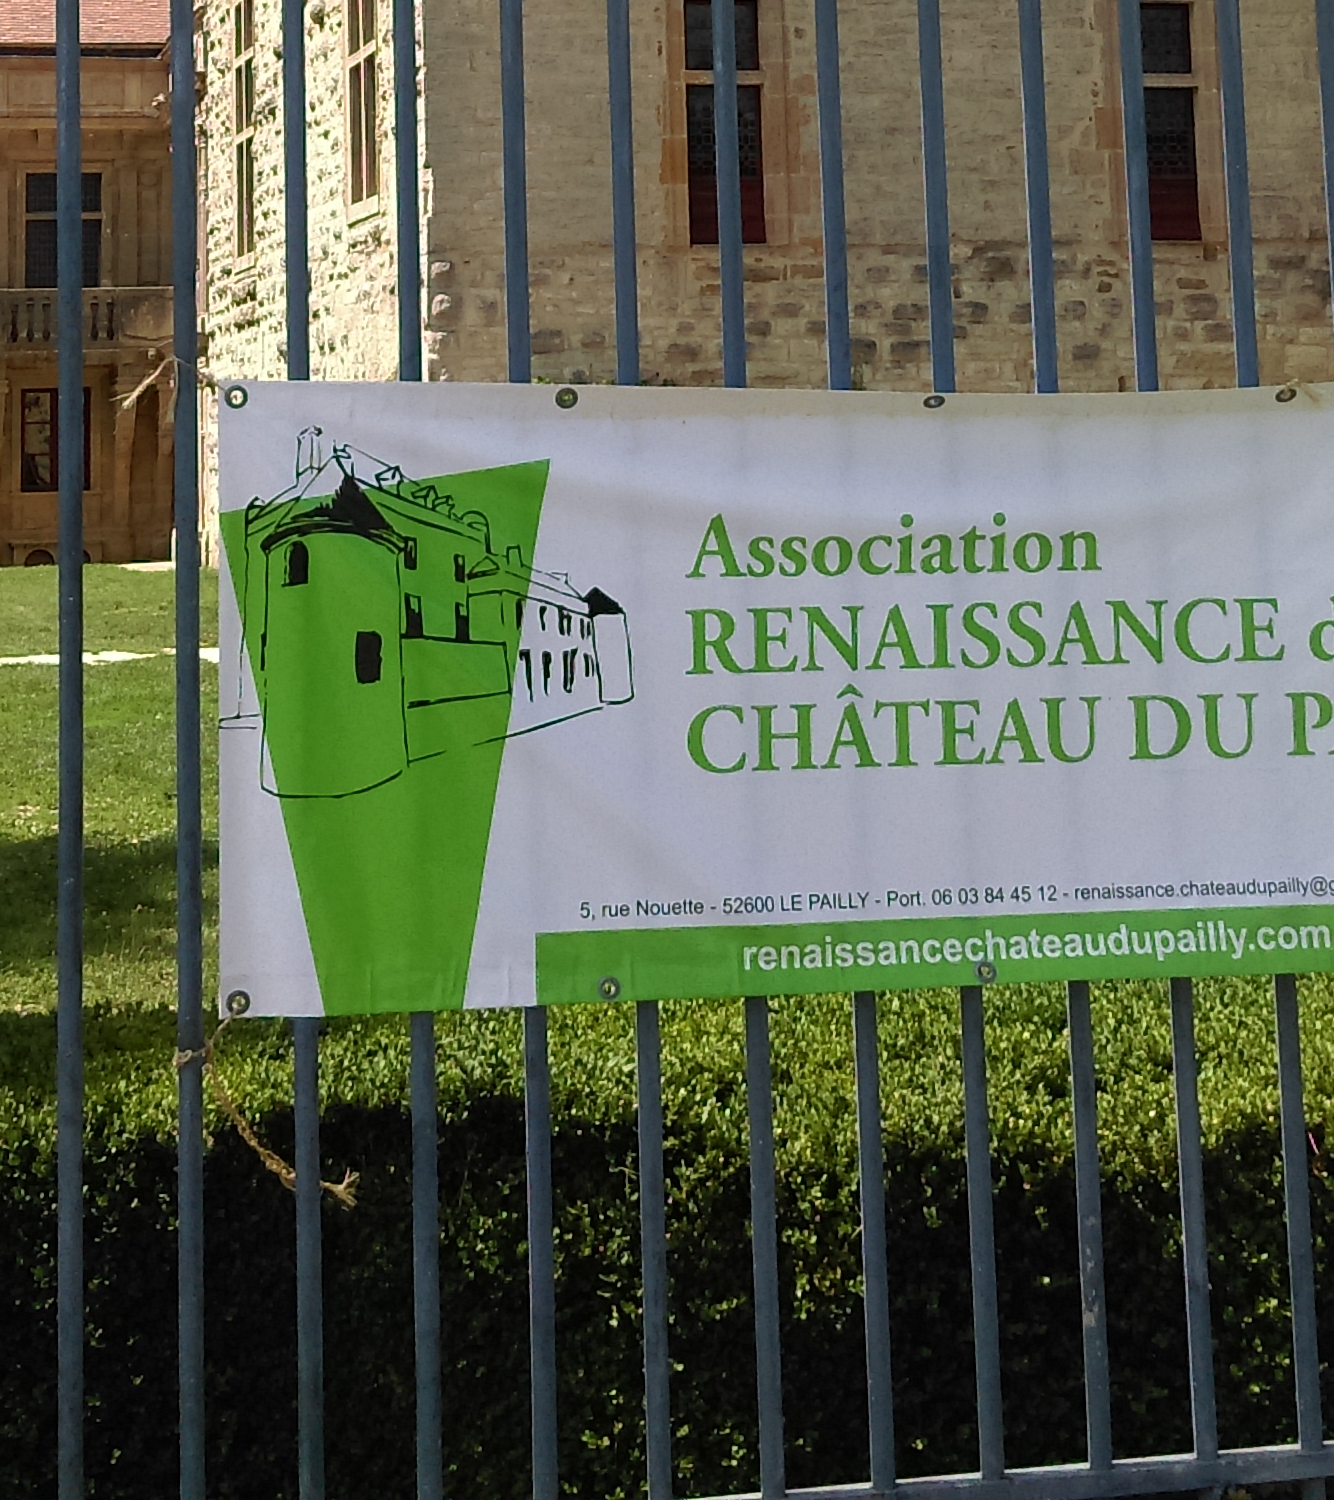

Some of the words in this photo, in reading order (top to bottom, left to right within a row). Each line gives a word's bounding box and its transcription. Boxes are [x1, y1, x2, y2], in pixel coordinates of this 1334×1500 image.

[685, 512, 1102, 578] Association
[685, 597, 1285, 675] RENAISSANCE
[685, 683, 1102, 774] CHÂTEAU
[1127, 693, 1259, 760] DU
[579, 902, 596, 920] 5,
[601, 903, 630, 918] rue
[636, 899, 704, 917] Nouette
[722, 896, 775, 914] 52600
[780, 895, 802, 912] LE
[808, 891, 870, 911] PAILLY
[886, 889, 926, 908] Port.
[932, 888, 954, 906] 06
[958, 887, 979, 905] 03
[984, 886, 1005, 904] 84
[1010, 885, 1032, 903] 45
[1037, 884, 1058, 902] 12
[743, 920, 1331, 971] renaissancechateaudupailly.com
